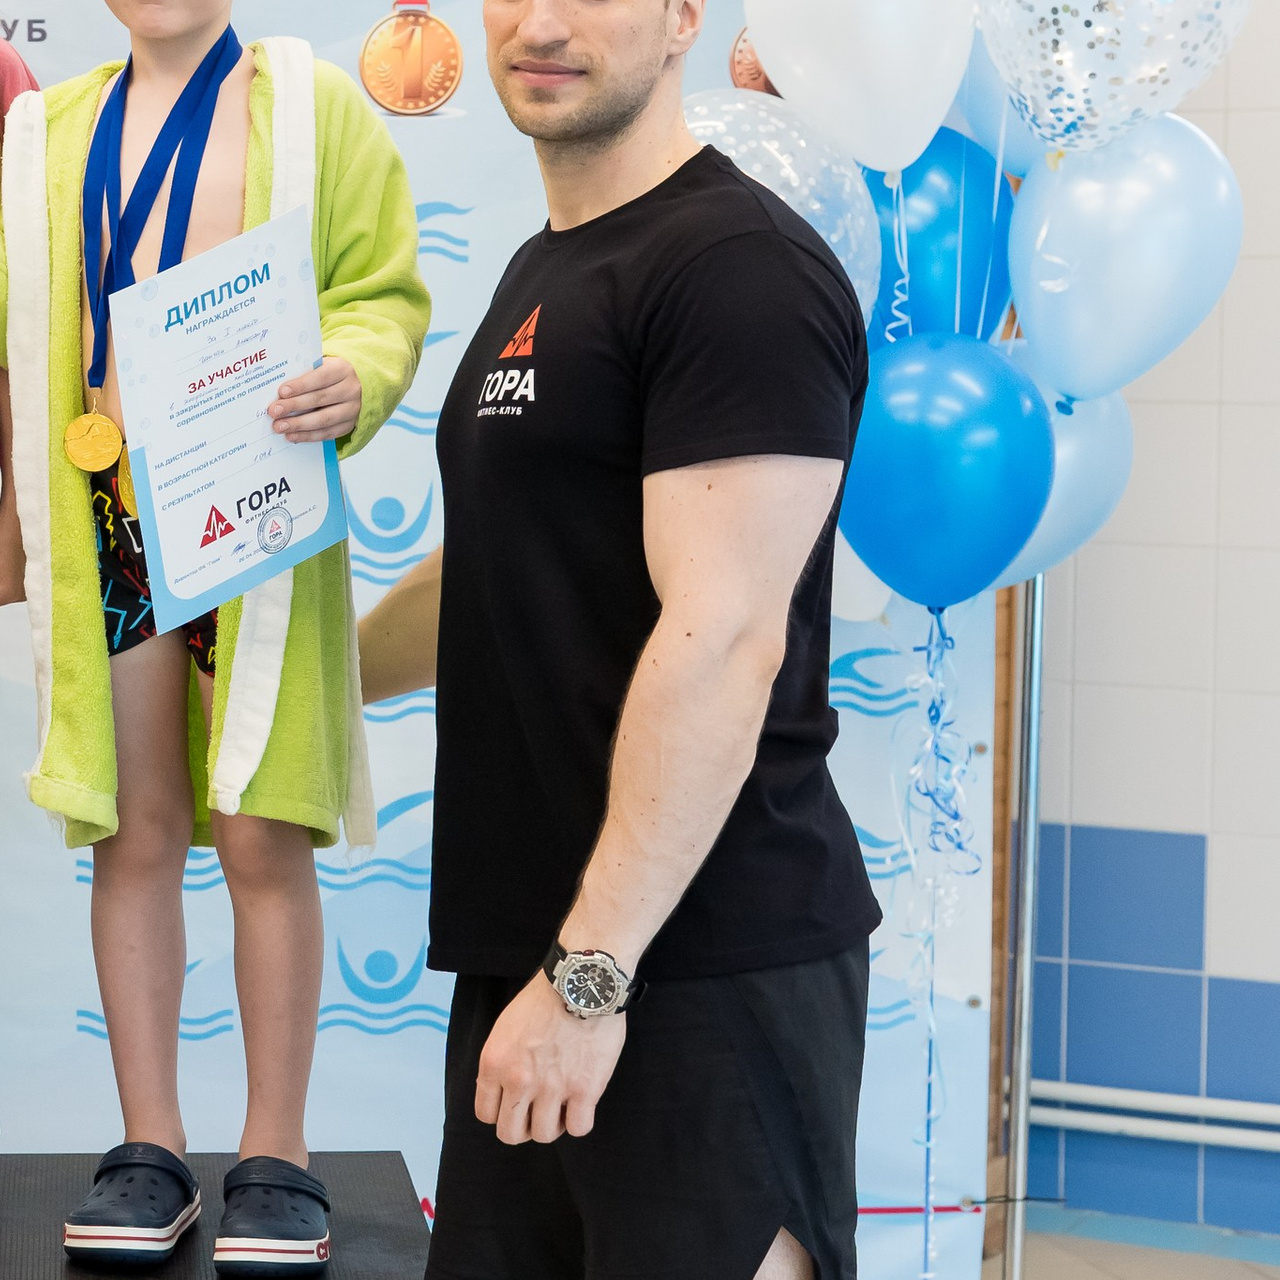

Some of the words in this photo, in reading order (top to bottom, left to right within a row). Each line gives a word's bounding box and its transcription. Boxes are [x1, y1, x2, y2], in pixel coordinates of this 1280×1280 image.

[164, 262, 271, 332] ДИПЛОМ
[185, 296, 256, 335] НАГРАЖДАЕТСЯ
[175, 396, 214, 418] закрытых
[214, 359, 289, 399] детско-юношеских
[188, 379, 206, 394] ЗА
[207, 348, 267, 385] УЧАСТИЕ
[478, 368, 535, 405] ГОРА
[176, 396, 236, 428] соревнованиях
[236, 390, 247, 399] по
[247, 372, 286, 394] плаванию
[154, 462, 164, 470] НА
[165, 441, 207, 466] ДИСТАНЦИИ
[163, 462, 209, 488] ВОЗРАСТНОЙ
[209, 442, 247, 466] КАТЕГОРИИ
[167, 480, 215, 508] РЕЗУЛЬТАТОМ
[236, 476, 291, 519] ГОРА
